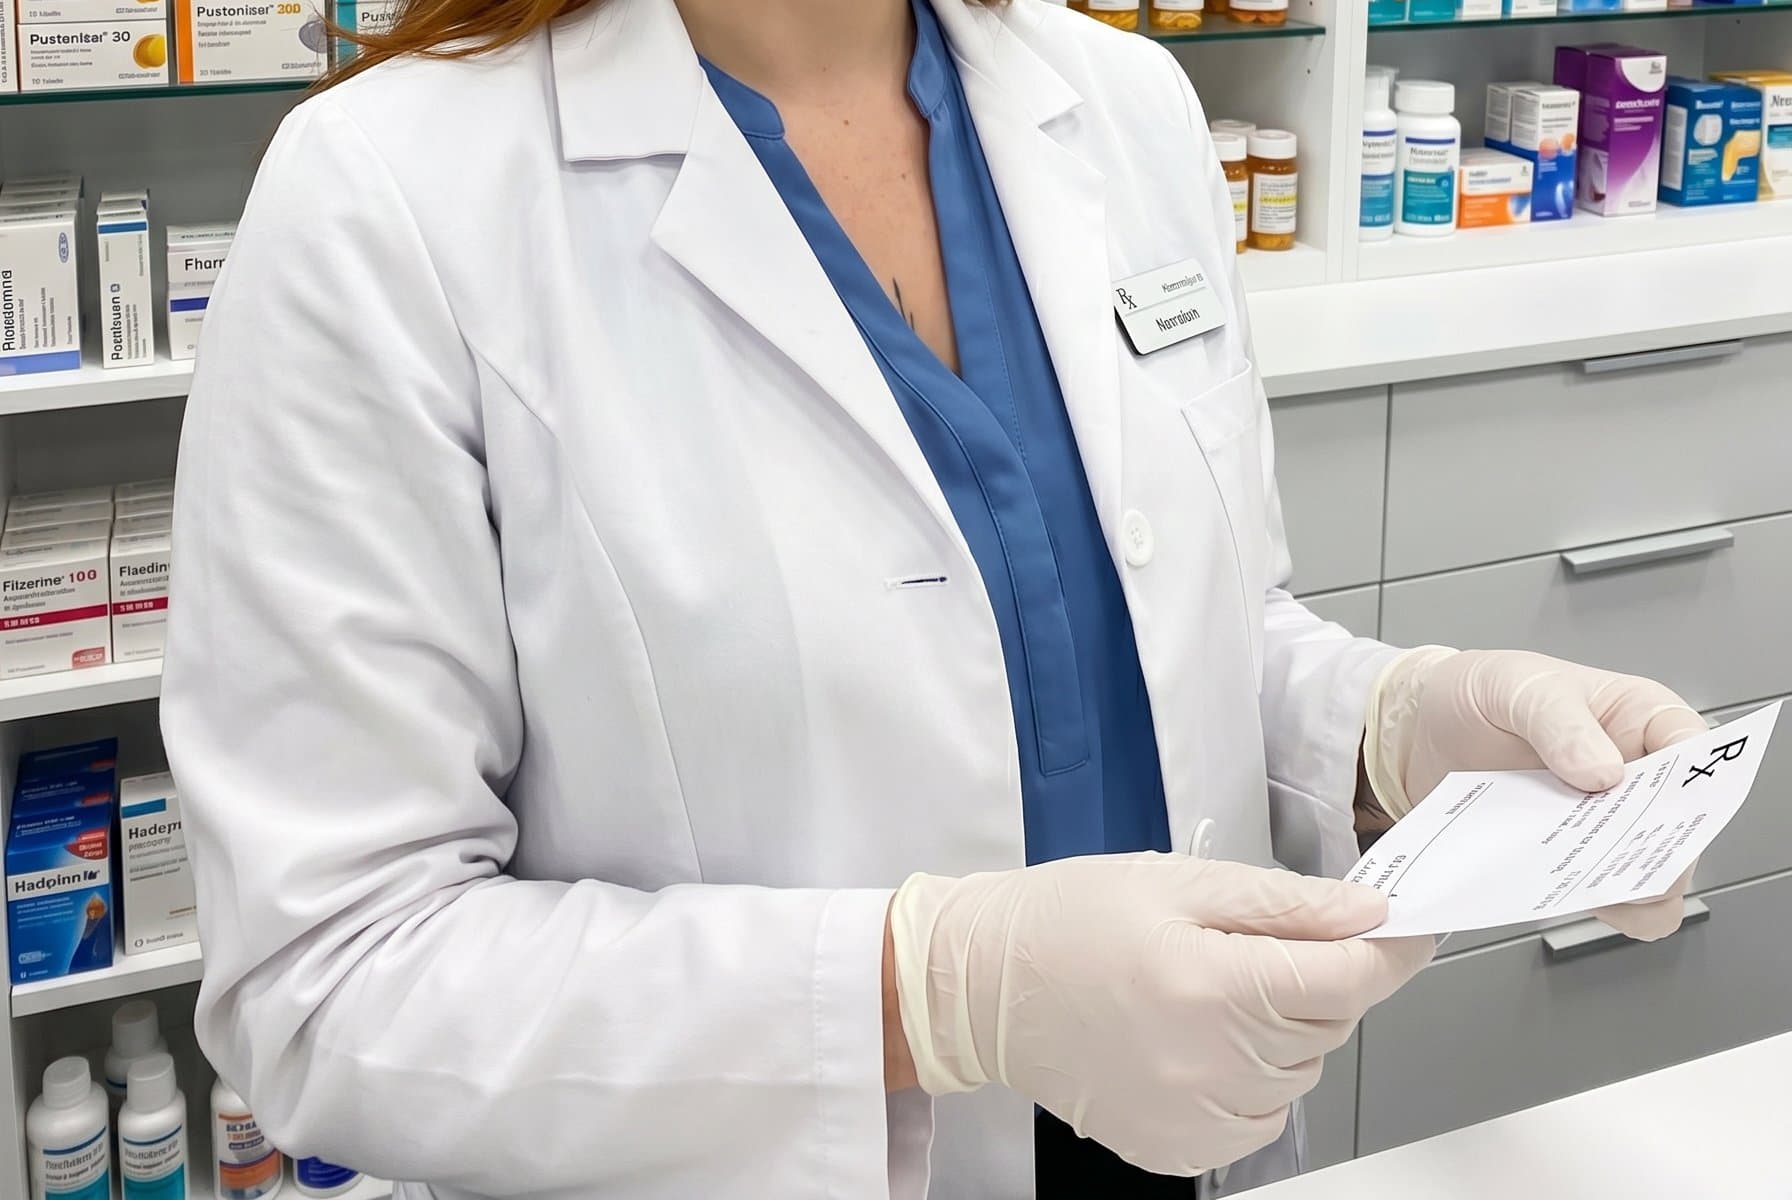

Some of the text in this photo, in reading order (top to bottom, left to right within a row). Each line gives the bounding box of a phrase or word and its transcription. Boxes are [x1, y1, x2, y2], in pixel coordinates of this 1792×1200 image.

[112, 31, 131, 42] 30
[1116, 288, 1138, 310] Rx
[1682, 735, 1749, 787] Rx
